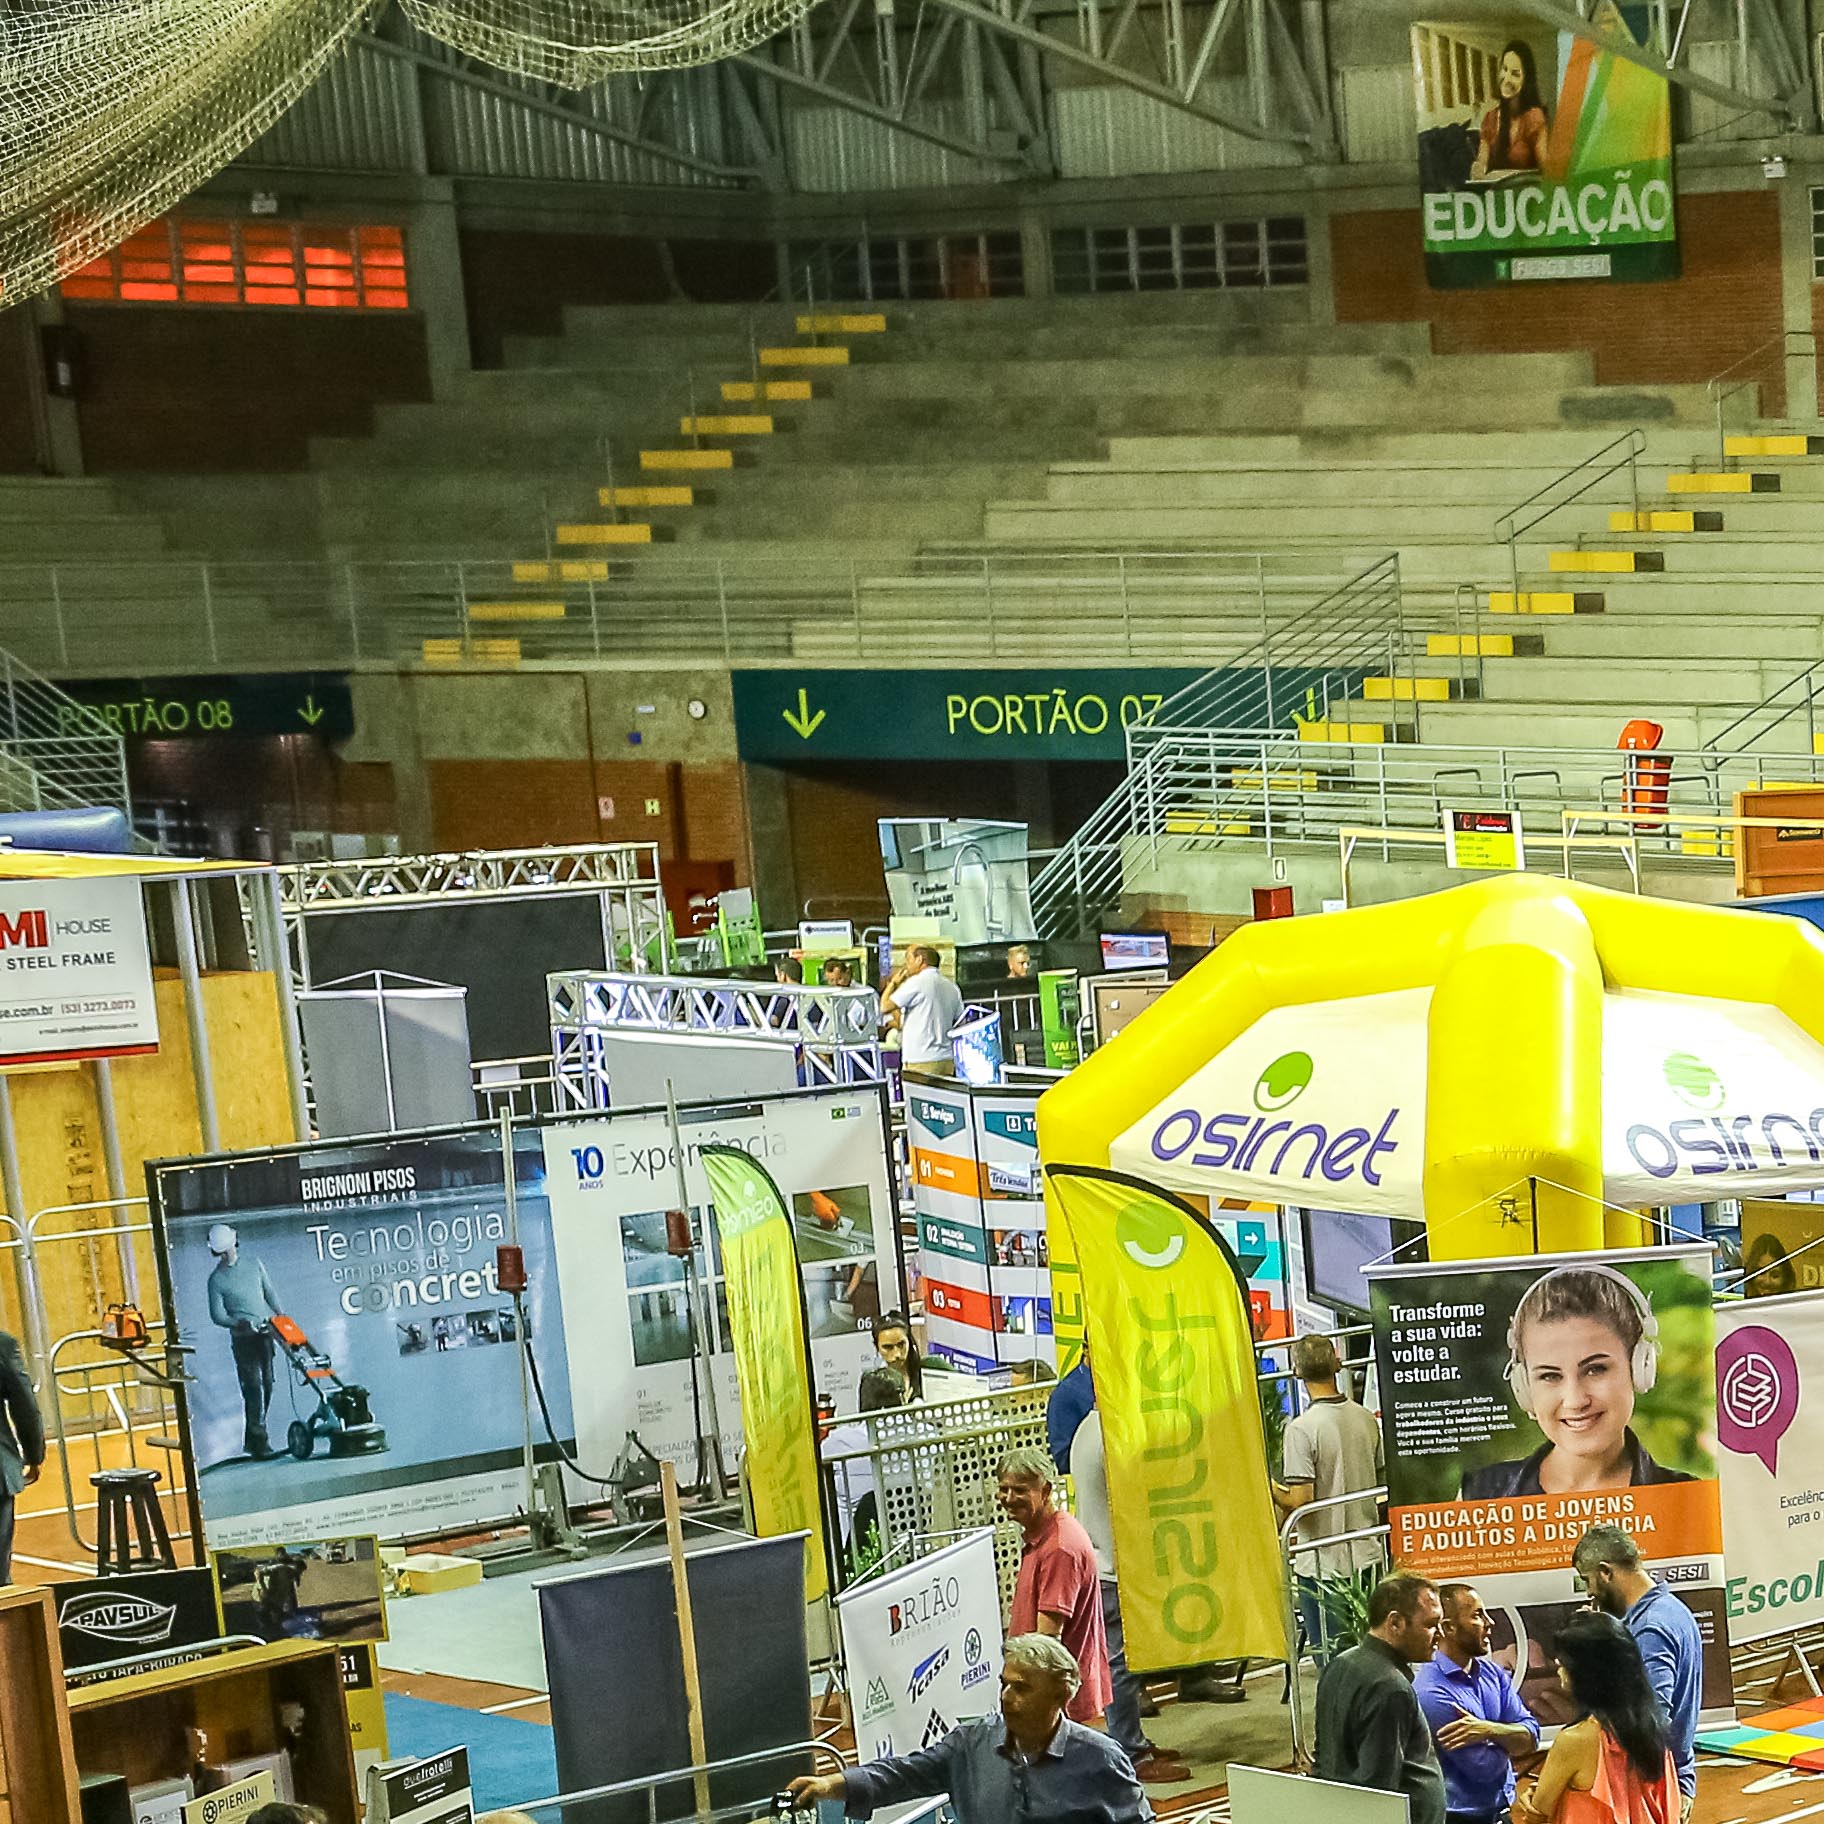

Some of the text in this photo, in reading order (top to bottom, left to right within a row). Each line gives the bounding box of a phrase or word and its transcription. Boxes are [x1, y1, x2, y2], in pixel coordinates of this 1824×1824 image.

[1423, 169, 1673, 246] EDUCAÇÃO
[56, 697, 233, 735] PORTÃO 08
[946, 689, 1163, 736] PORTÃO 07
[56, 918, 111, 935] HOUSE
[7, 951, 116, 970] STEEL FRAME
[1150, 1106, 1400, 1188] osirnet
[570, 1145, 604, 1179] 10
[920, 1159, 932, 1178] 01
[301, 1166, 416, 1200] BRIGNONI PISOS
[303, 1191, 418, 1213] INDUSTRIAIS
[306, 1205, 505, 1262] Tecnologia
[926, 1224, 938, 1243] 02
[425, 1247, 450, 1270] de
[340, 1260, 499, 1315] concret
[933, 1289, 945, 1308] 03
[857, 1318, 872, 1330] 06
[1389, 1303, 1485, 1323] Transforme
[1391, 1321, 1482, 1343] a sua vida:
[1392, 1345, 1449, 1363] volte a
[1394, 1364, 1461, 1384] estudar.
[1395, 1400, 1422, 1410] Comece
[1444, 1404, 1508, 1416] Curso gratuito para
[1398, 1438, 1414, 1447] Você
[1435, 1435, 1458, 1445] família
[1401, 1494, 1634, 1533] EDUCAÇÃO DE JOVENS
[1788, 1512, 1810, 1528] para
[1402, 1525, 1536, 1553] E ADULTOS A
[1666, 1565, 1703, 1580] SESI
[80, 1605, 160, 1627] PAVSUL
[888, 1576, 959, 1637] BRIÃO
[960, 1661, 991, 1686] PIERINI
[219, 1787, 259, 1811] PIERINI
